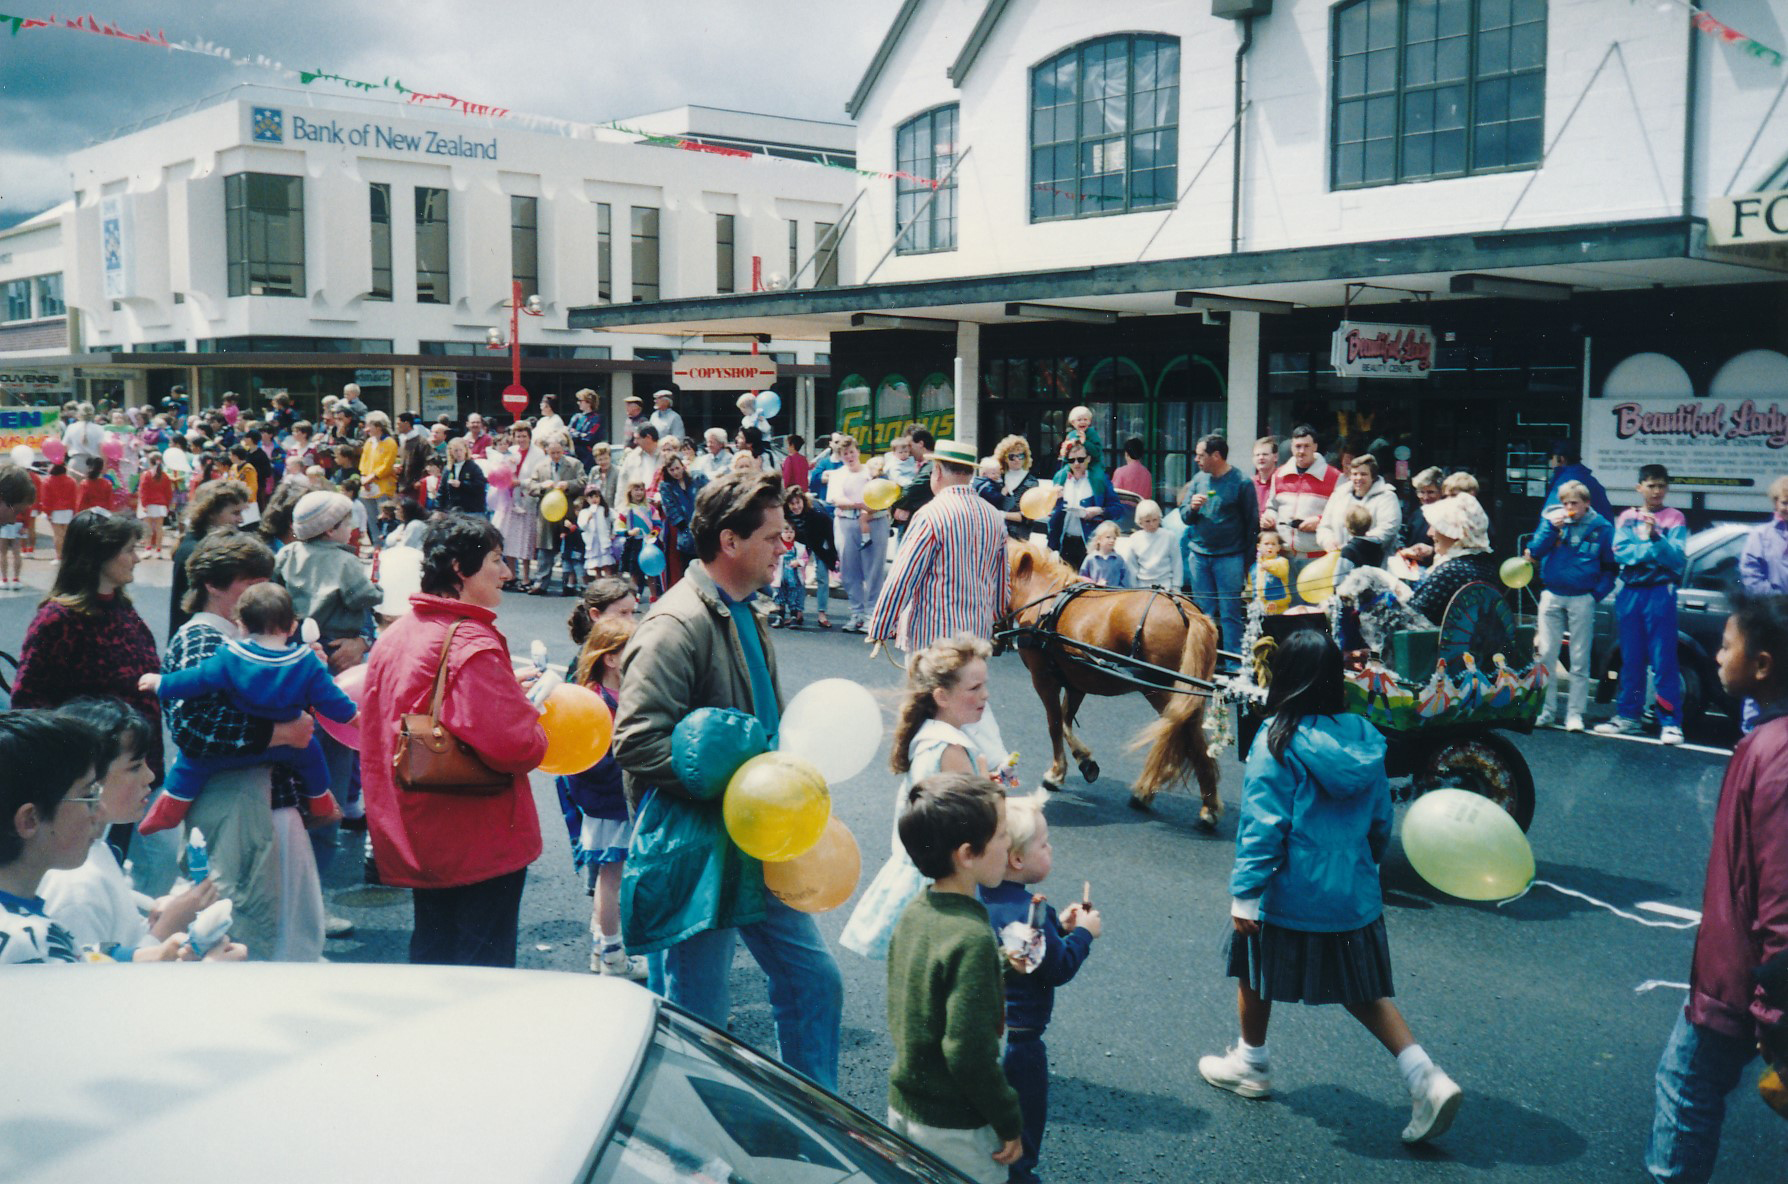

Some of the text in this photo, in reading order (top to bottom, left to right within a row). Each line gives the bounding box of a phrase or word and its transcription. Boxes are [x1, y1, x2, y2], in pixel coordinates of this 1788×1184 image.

[292, 116, 498, 161] Bank of New Zealand
[689, 367, 758, 379] COPYSHOP
[1612, 399, 1788, 449] Beautiful Lady
